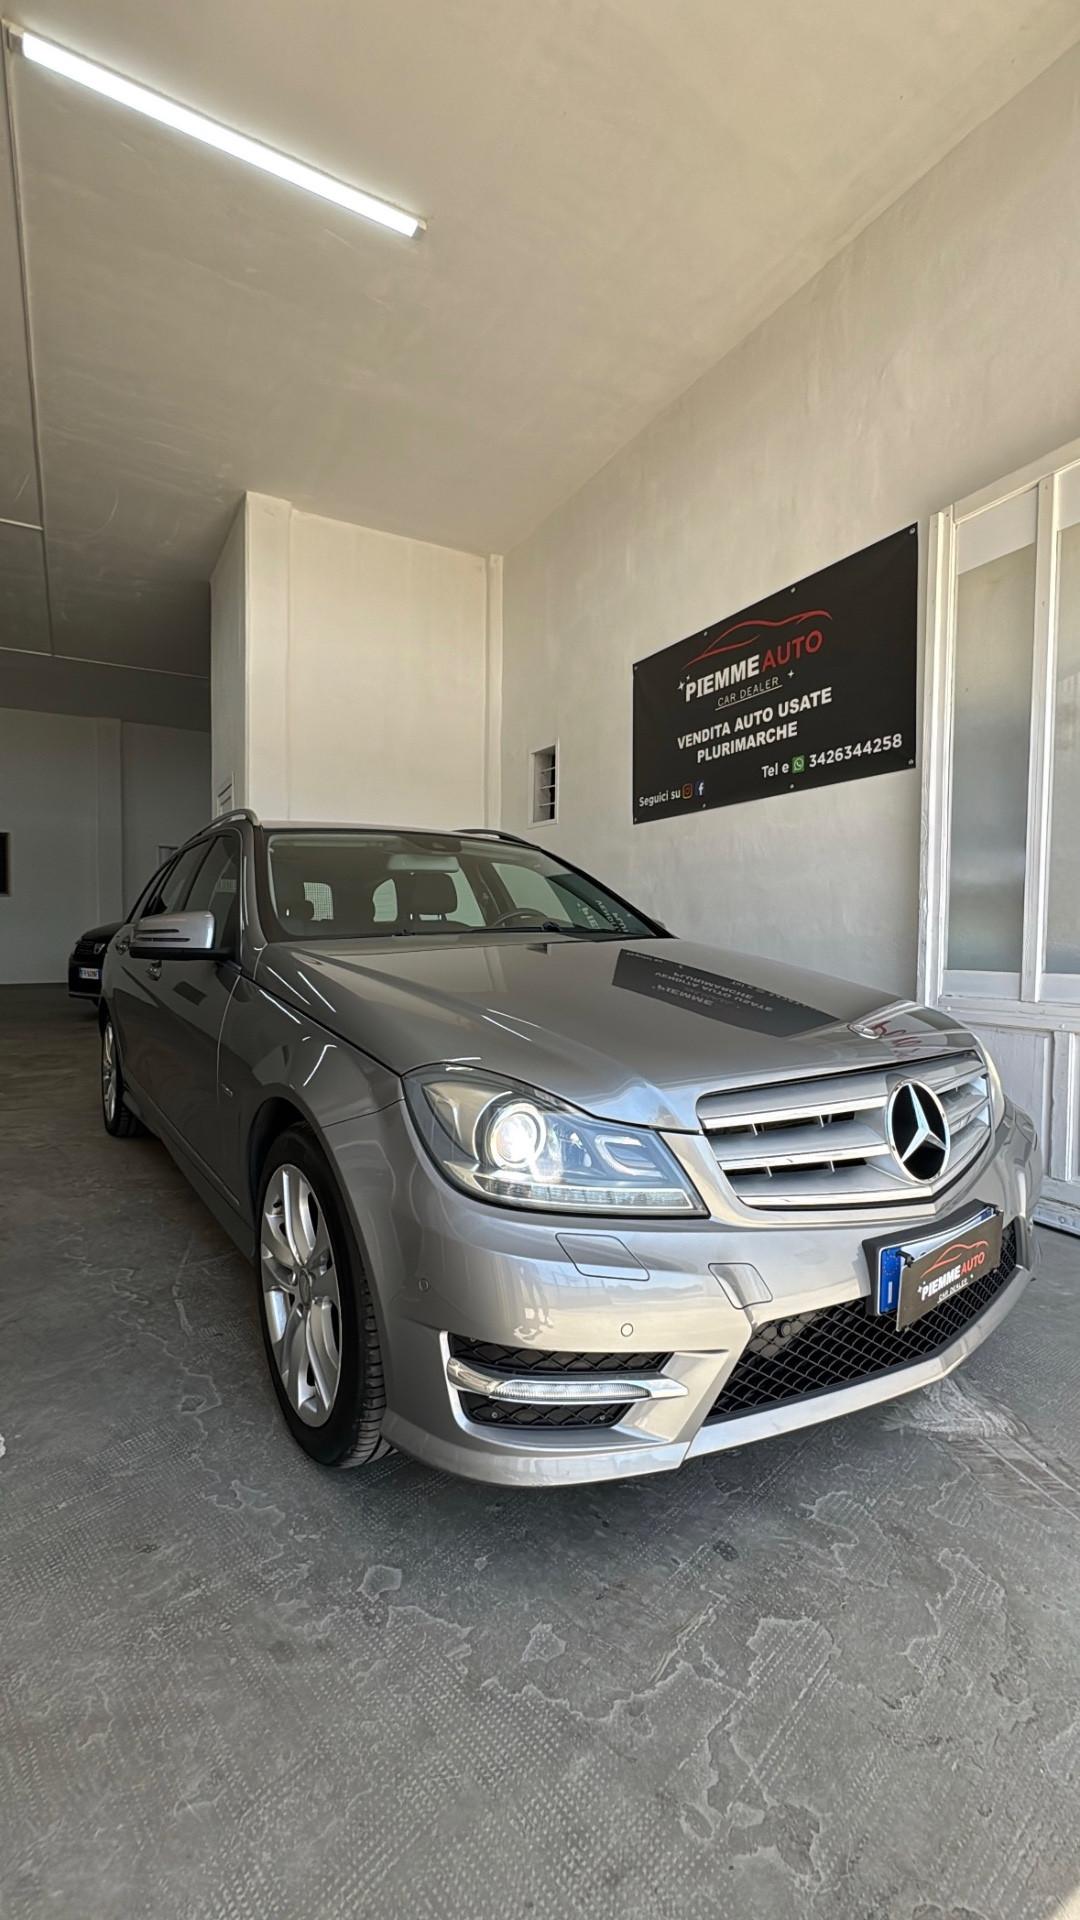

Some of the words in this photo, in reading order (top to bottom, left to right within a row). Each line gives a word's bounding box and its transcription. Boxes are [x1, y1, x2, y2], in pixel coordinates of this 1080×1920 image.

[717, 692, 737, 707] CAR
[740, 676, 779, 699] DEALER
[677, 721, 731, 750] VENDITA
[734, 707, 774, 732] AUTO
[778, 687, 832, 717] USATE
[697, 721, 798, 763] PLURIMARCHE
[761, 762, 778, 778] Tel
[781, 763, 790, 773] e
[809, 733, 902, 768] 3426344258
[639, 790, 669, 807] Seguici
[671, 790, 681, 800] su
